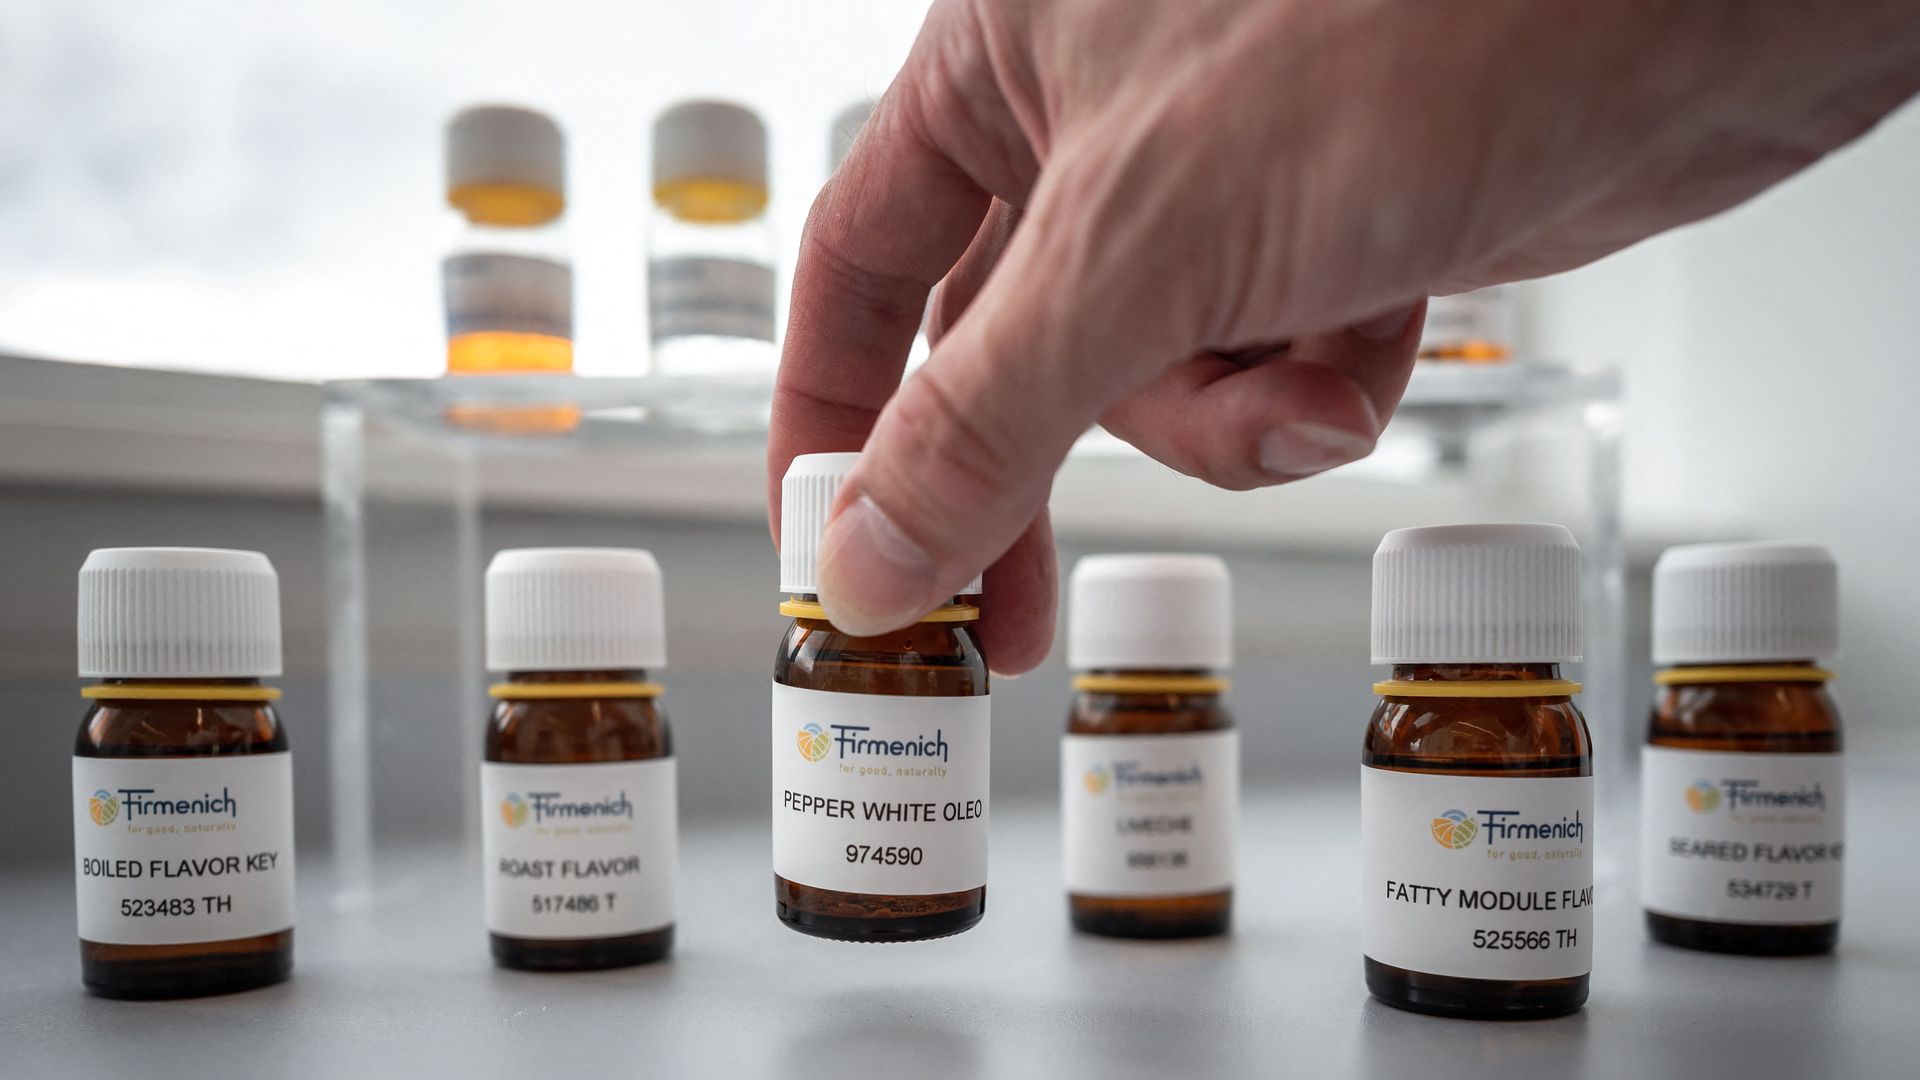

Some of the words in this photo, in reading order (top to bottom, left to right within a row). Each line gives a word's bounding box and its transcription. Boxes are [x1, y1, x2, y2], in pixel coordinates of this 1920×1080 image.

[830, 724, 948, 762] Firmenich
[839, 764, 854, 773] for
[859, 766, 891, 776] good,
[896, 766, 948, 778] naturally
[118, 787, 237, 821] Firmenich
[527, 790, 633, 823] Firmenich
[784, 790, 855, 819] PEPPER
[863, 802, 936, 822] WHITE
[943, 799, 982, 821] OLEO
[1721, 778, 1826, 812] Firmenich
[127, 825, 143, 834] for
[184, 822, 237, 833] naturally
[1477, 809, 1583, 844] Firmenich
[83, 858, 142, 878] BOILED
[150, 856, 240, 877] FLAVOR
[247, 852, 278, 872] KEY
[845, 844, 923, 865] 974590
[1487, 850, 1504, 859] for
[499, 858, 554, 878] ROAST
[562, 856, 640, 878] FLAVOR
[121, 898, 195, 917] 523483
[202, 895, 232, 914] TH
[606, 893, 617, 911] T
[1386, 881, 1452, 907] FATTY
[1459, 889, 1557, 911] MODULE
[1473, 930, 1550, 950] 525566
[1556, 928, 1577, 948] TH
